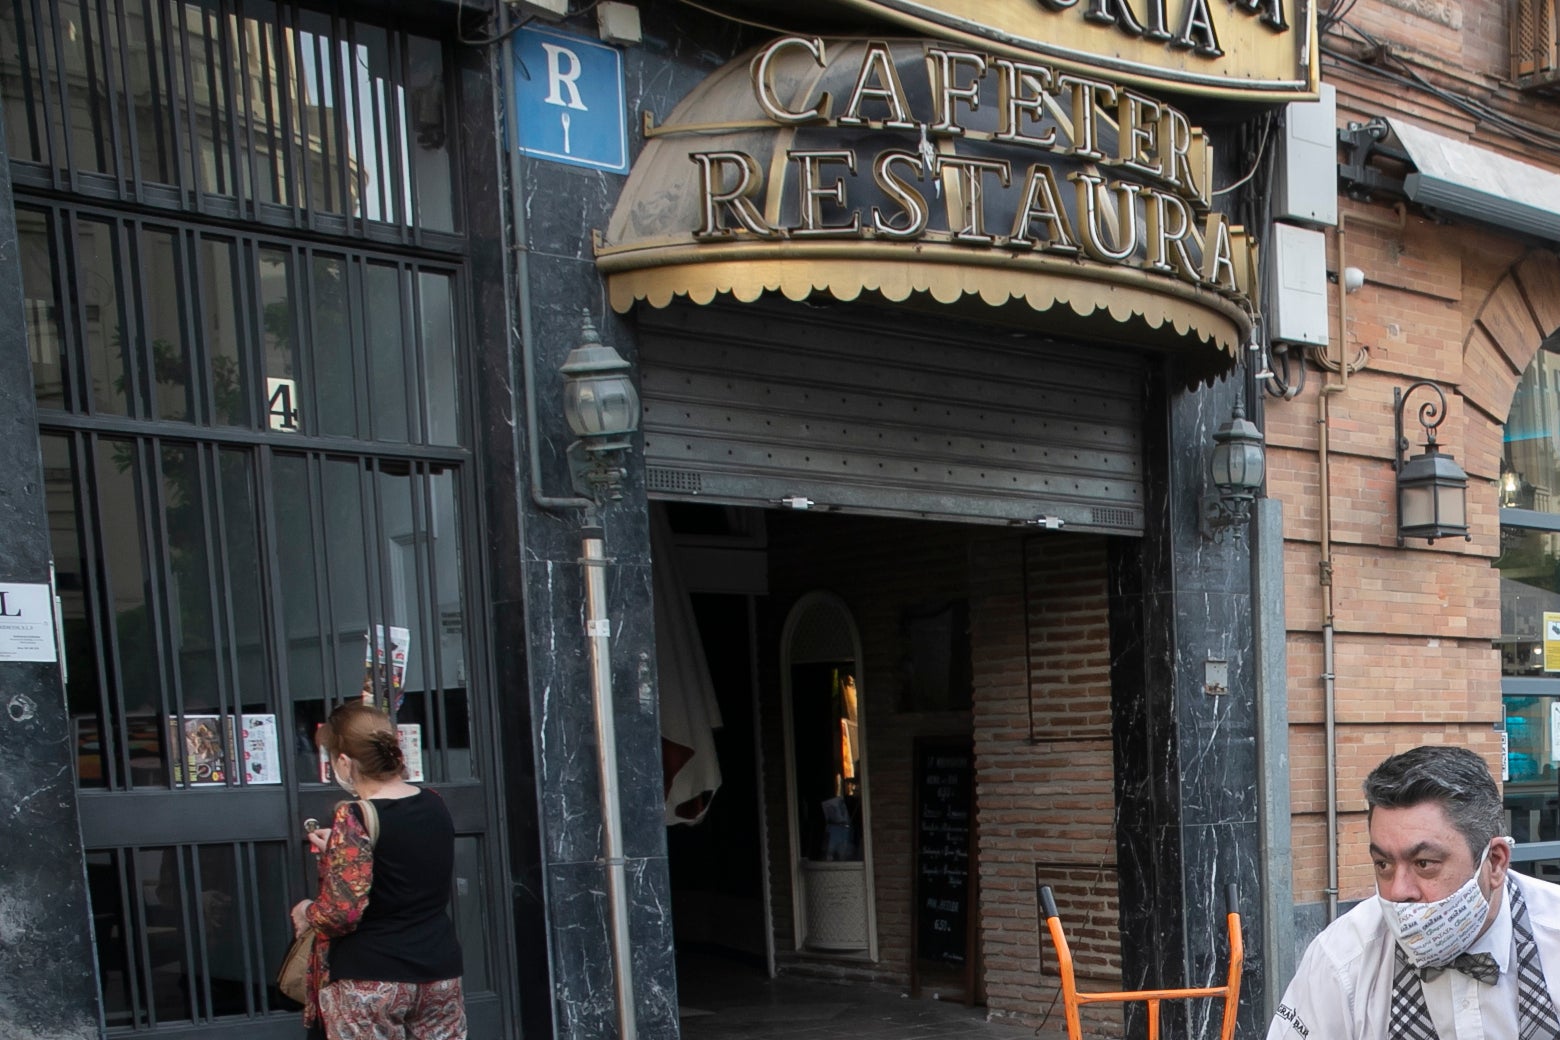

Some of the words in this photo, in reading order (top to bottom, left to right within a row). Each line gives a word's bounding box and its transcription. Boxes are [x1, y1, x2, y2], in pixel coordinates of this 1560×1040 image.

[541, 43, 589, 112] R
[688, 148, 1256, 300] RESTAURA
[268, 384, 298, 428] 4
[1292, 1018, 1310, 1039] BAR
